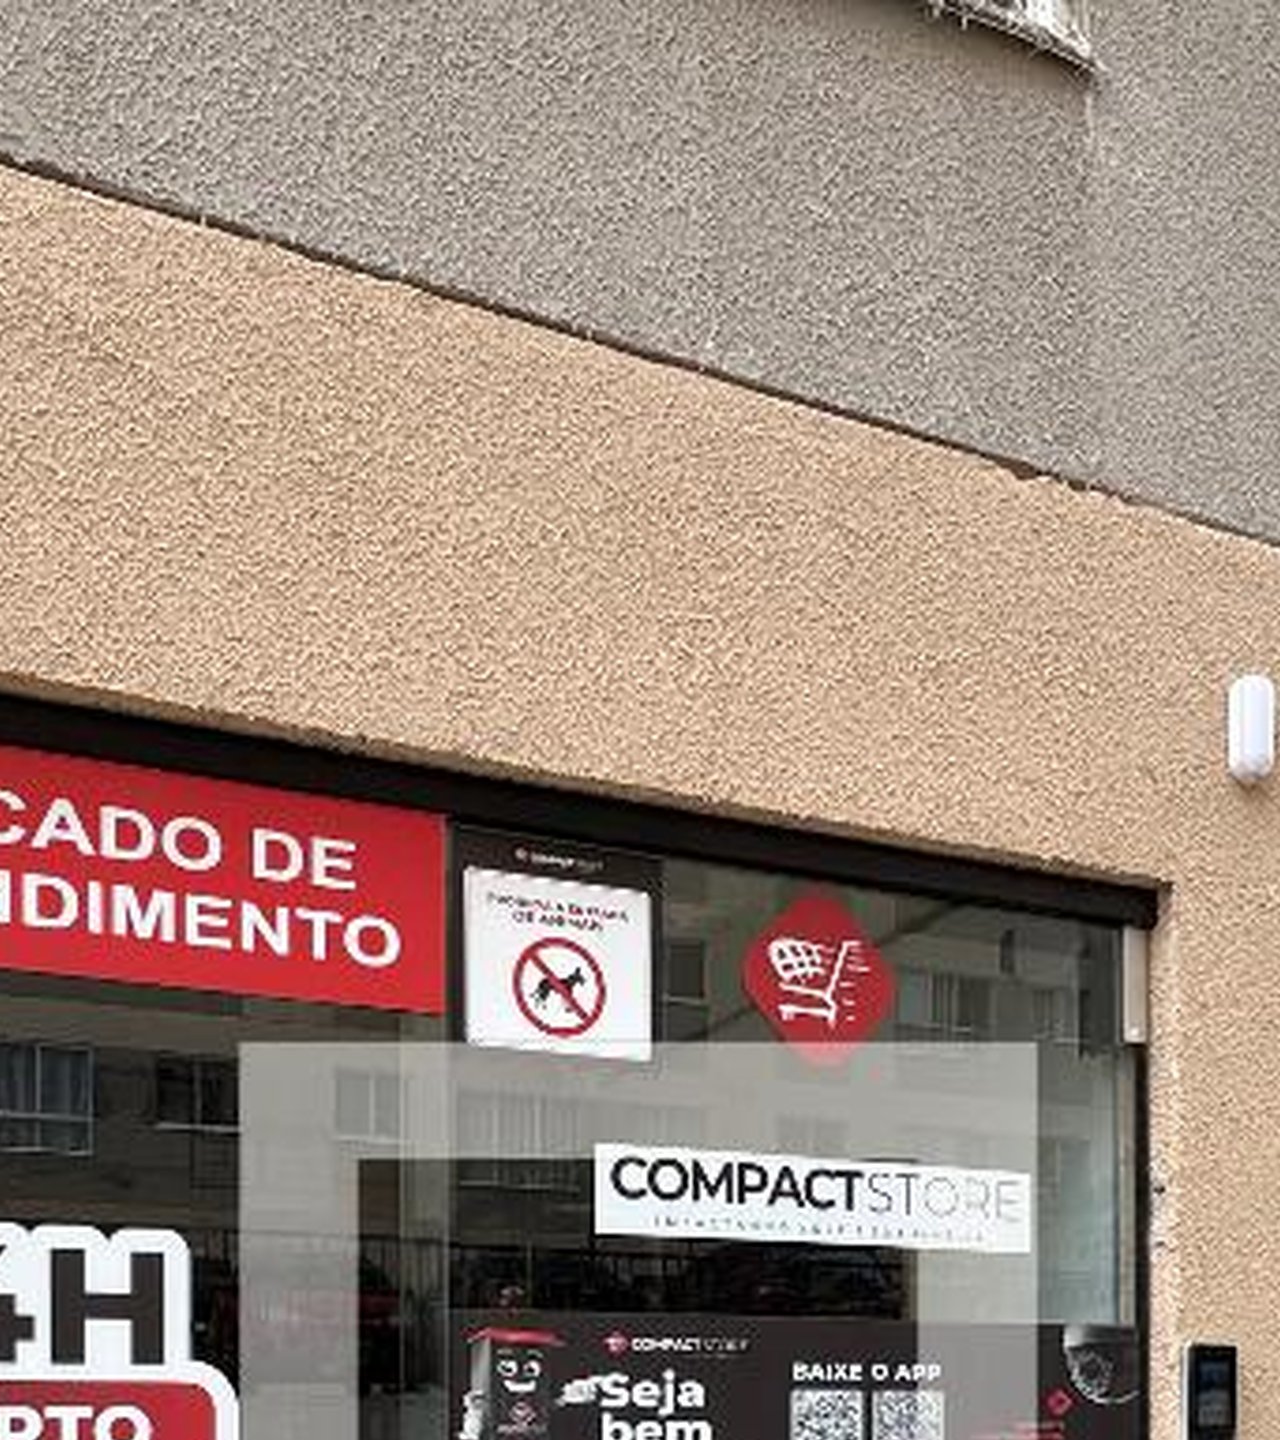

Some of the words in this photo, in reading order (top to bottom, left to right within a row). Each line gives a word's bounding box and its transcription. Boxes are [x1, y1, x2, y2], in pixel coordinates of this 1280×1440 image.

[252, 827, 357, 890] DE
[599, 1369, 706, 1415] Seja
[792, 1363, 863, 1381] BAIXE
[872, 1364, 889, 1381] O
[894, 1364, 942, 1381] APP
